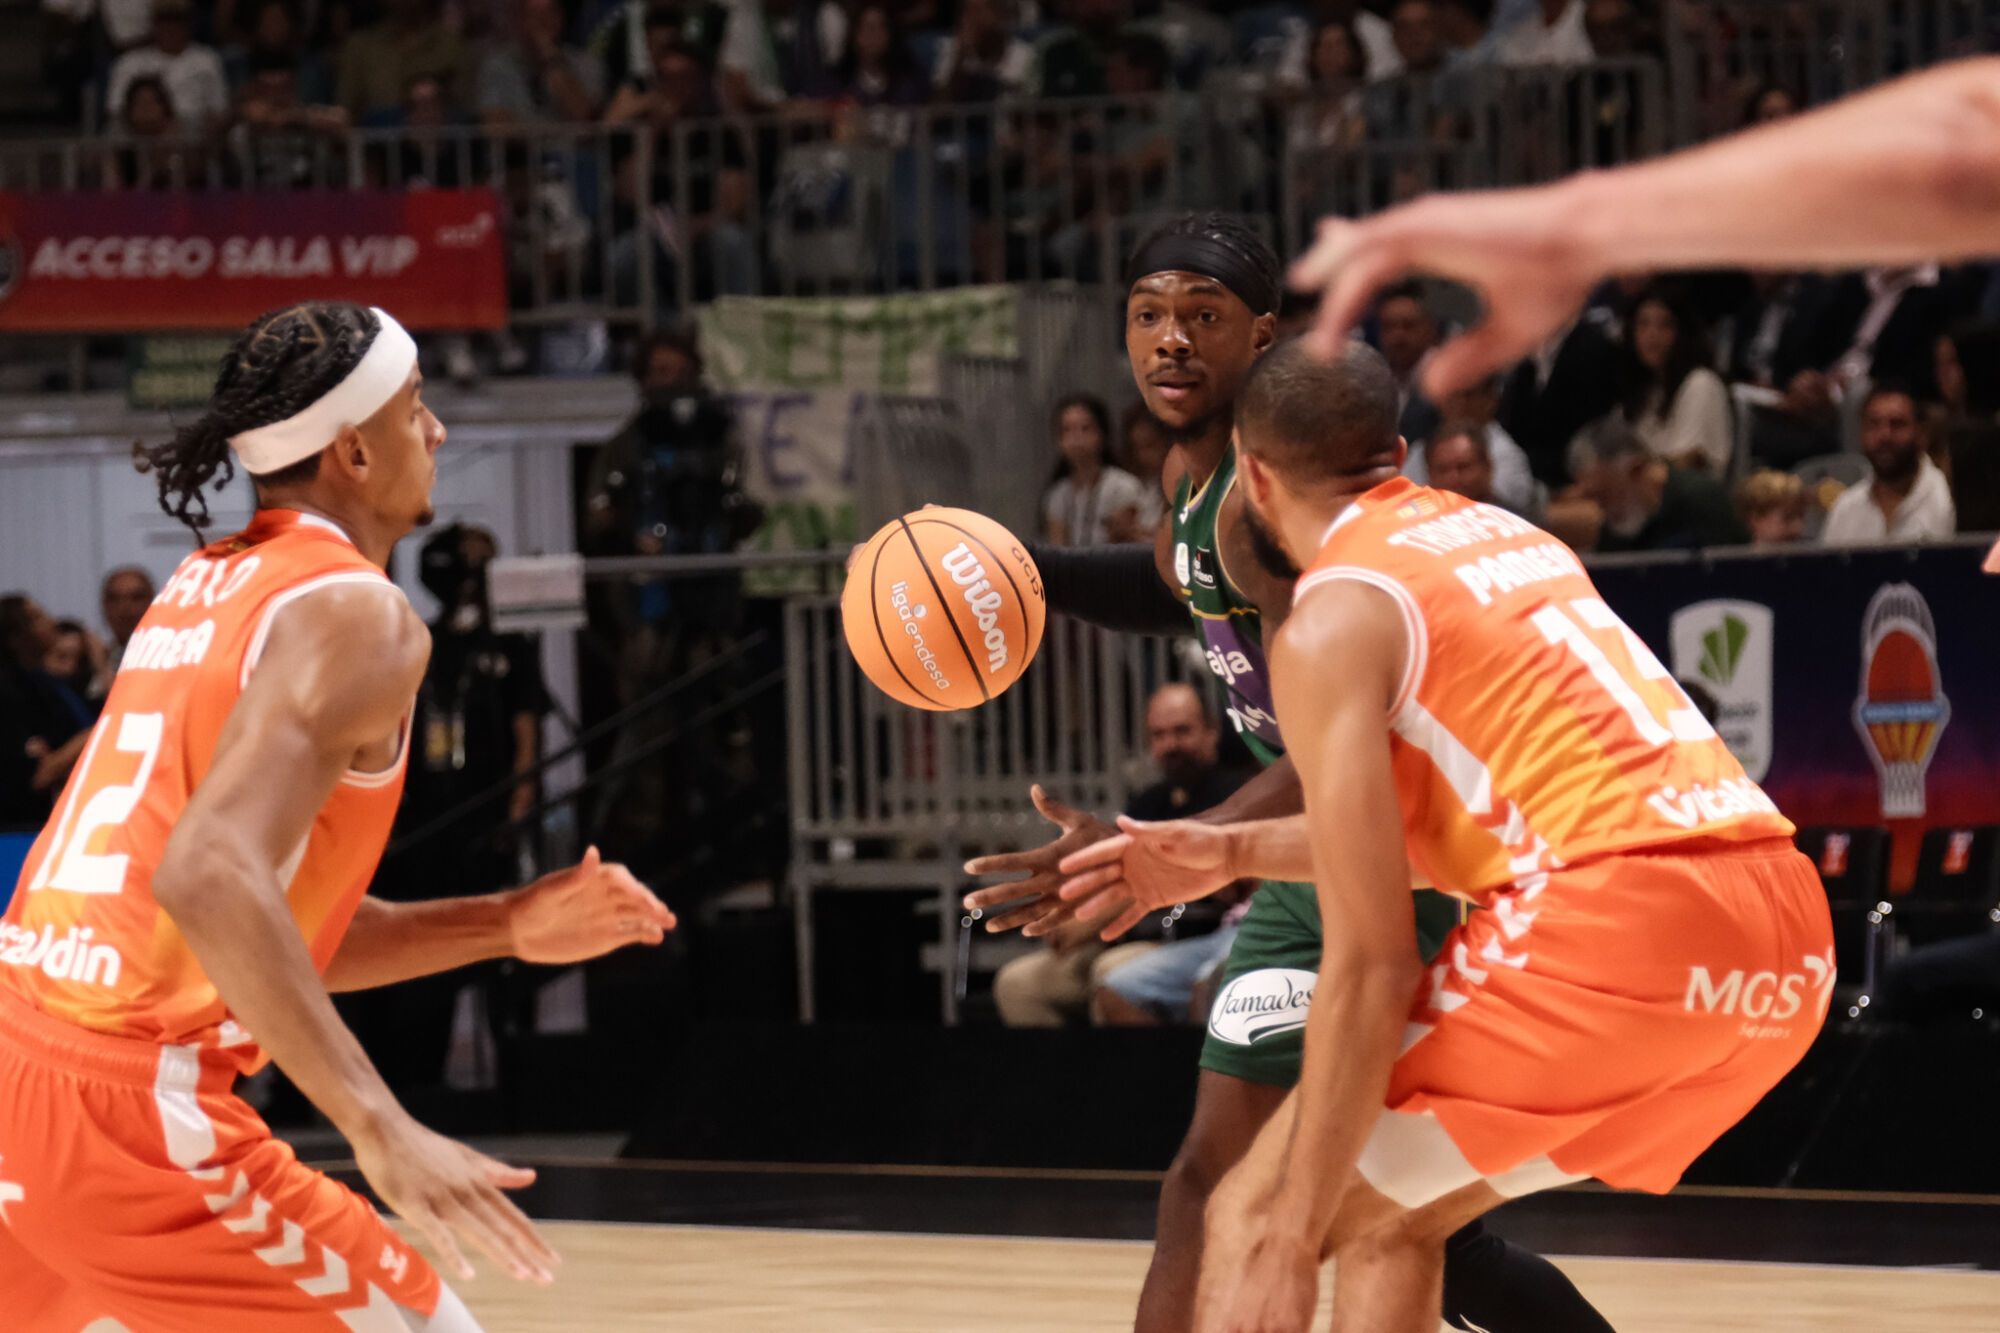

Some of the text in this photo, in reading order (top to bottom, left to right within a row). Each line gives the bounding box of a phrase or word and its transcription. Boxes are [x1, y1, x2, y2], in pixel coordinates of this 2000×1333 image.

[30, 235, 418, 279] ACCESO SALA VIP
[1011, 546, 1040, 598] acb
[890, 580, 951, 691] liga endesa
[940, 541, 1009, 675] Wilson
[1205, 644, 1254, 686] aja
[30, 712, 164, 895] 12
[0, 921, 122, 988] aldin
[1684, 965, 1806, 1020] MGS
